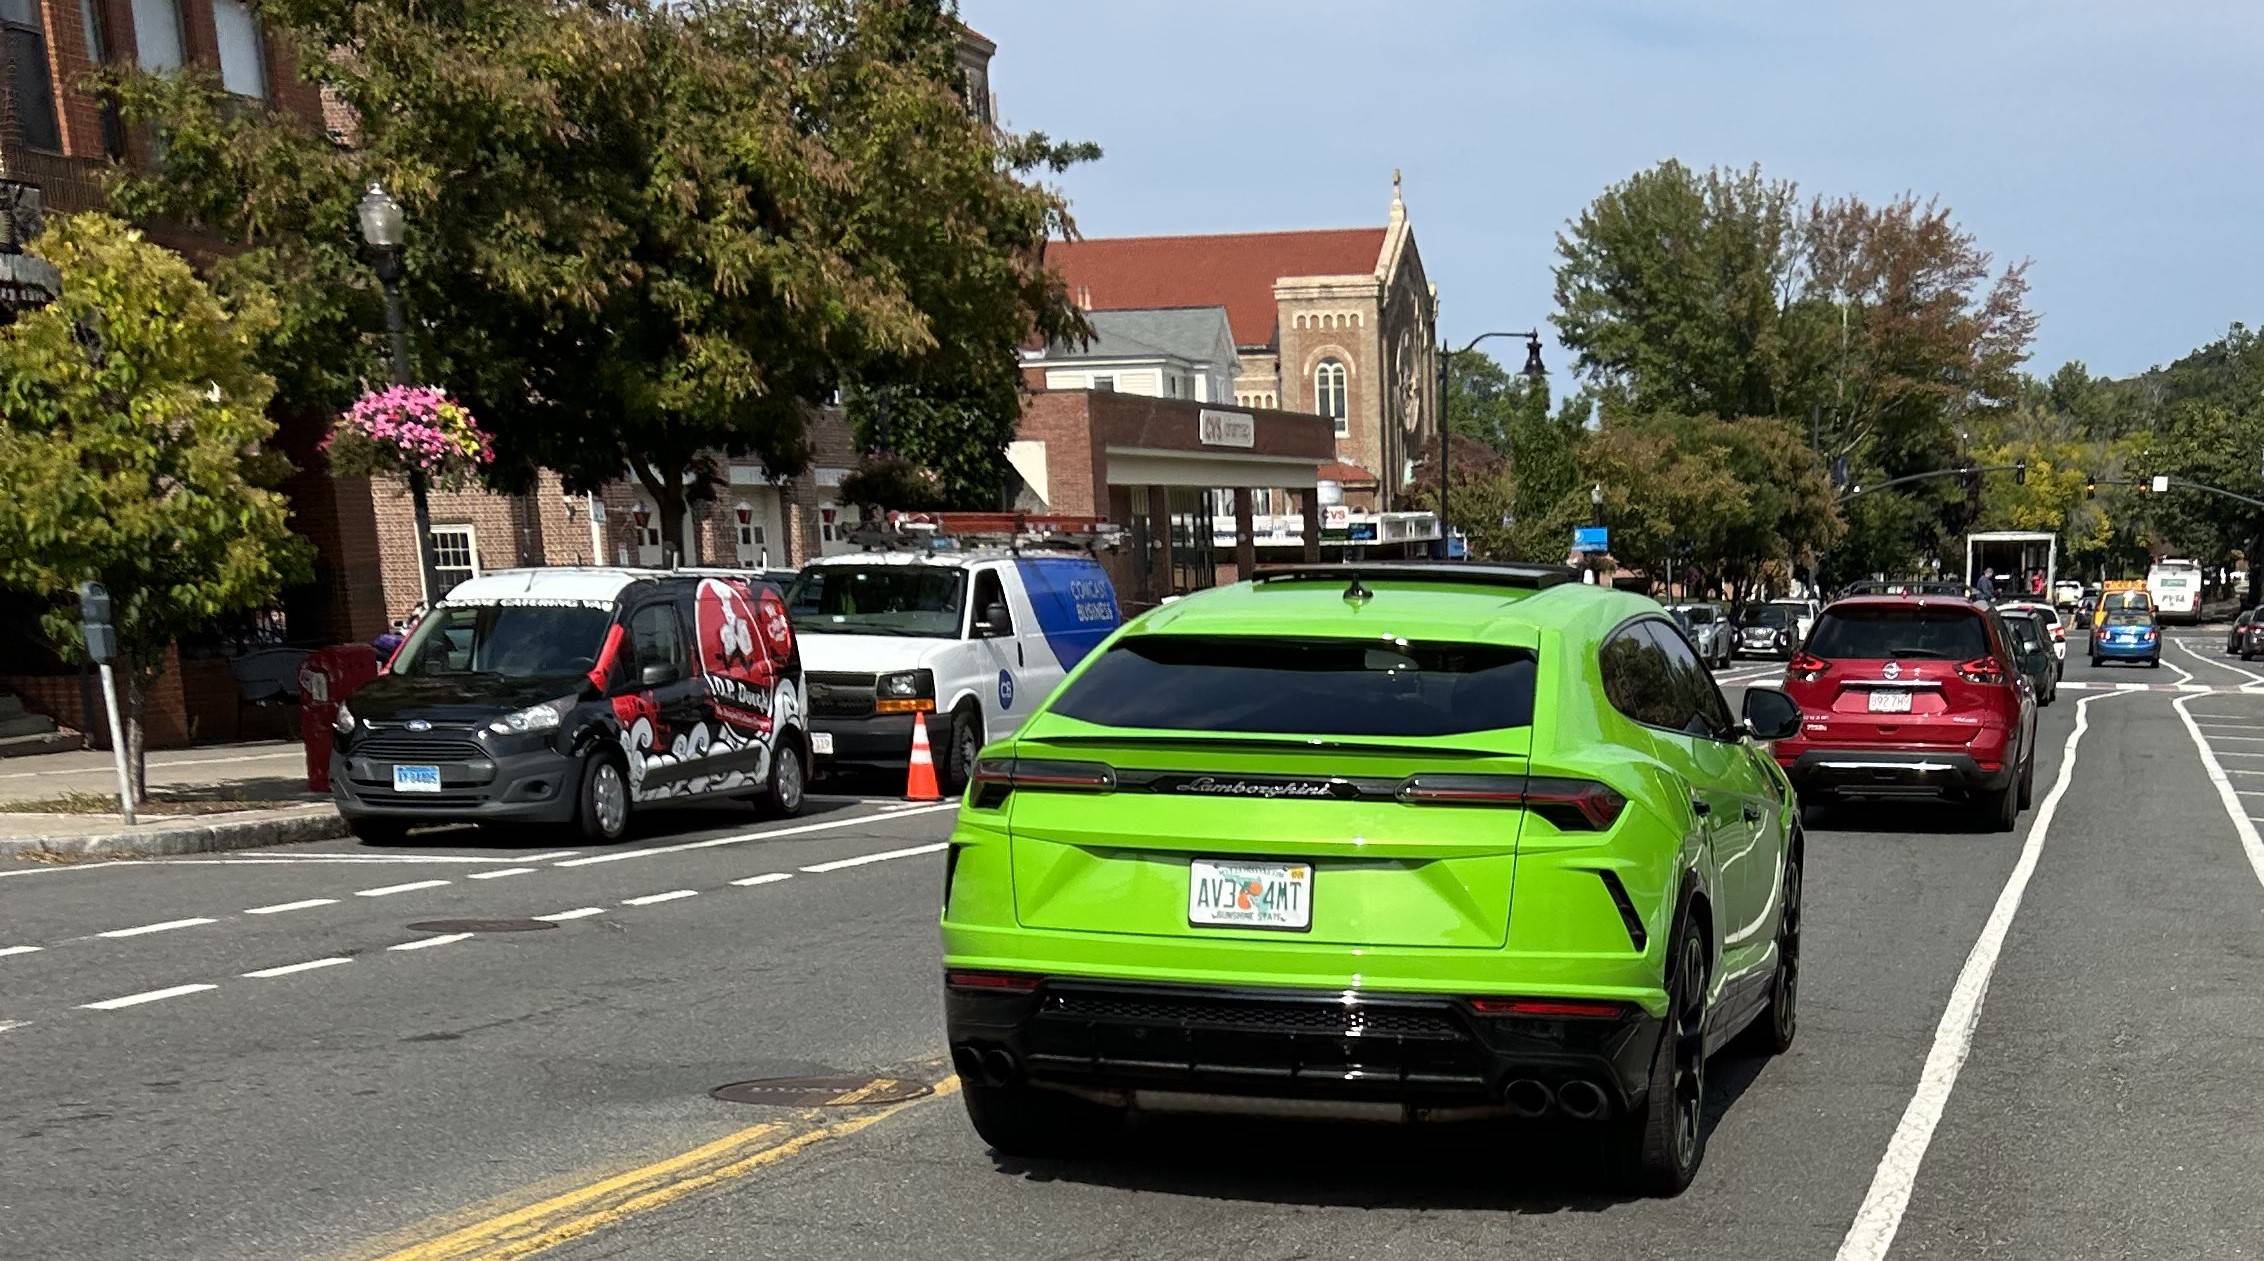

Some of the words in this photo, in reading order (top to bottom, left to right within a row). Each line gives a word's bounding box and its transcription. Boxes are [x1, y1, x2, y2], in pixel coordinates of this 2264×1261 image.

[1071, 580, 1105, 600] COMCAST
[1076, 602, 1113, 621] BUSINESS
[737, 681, 770, 714] Dough
[1176, 776, 1336, 797] Lamborghini
[1197, 878, 1237, 909] AV3
[1262, 880, 1302, 911] 4MT
